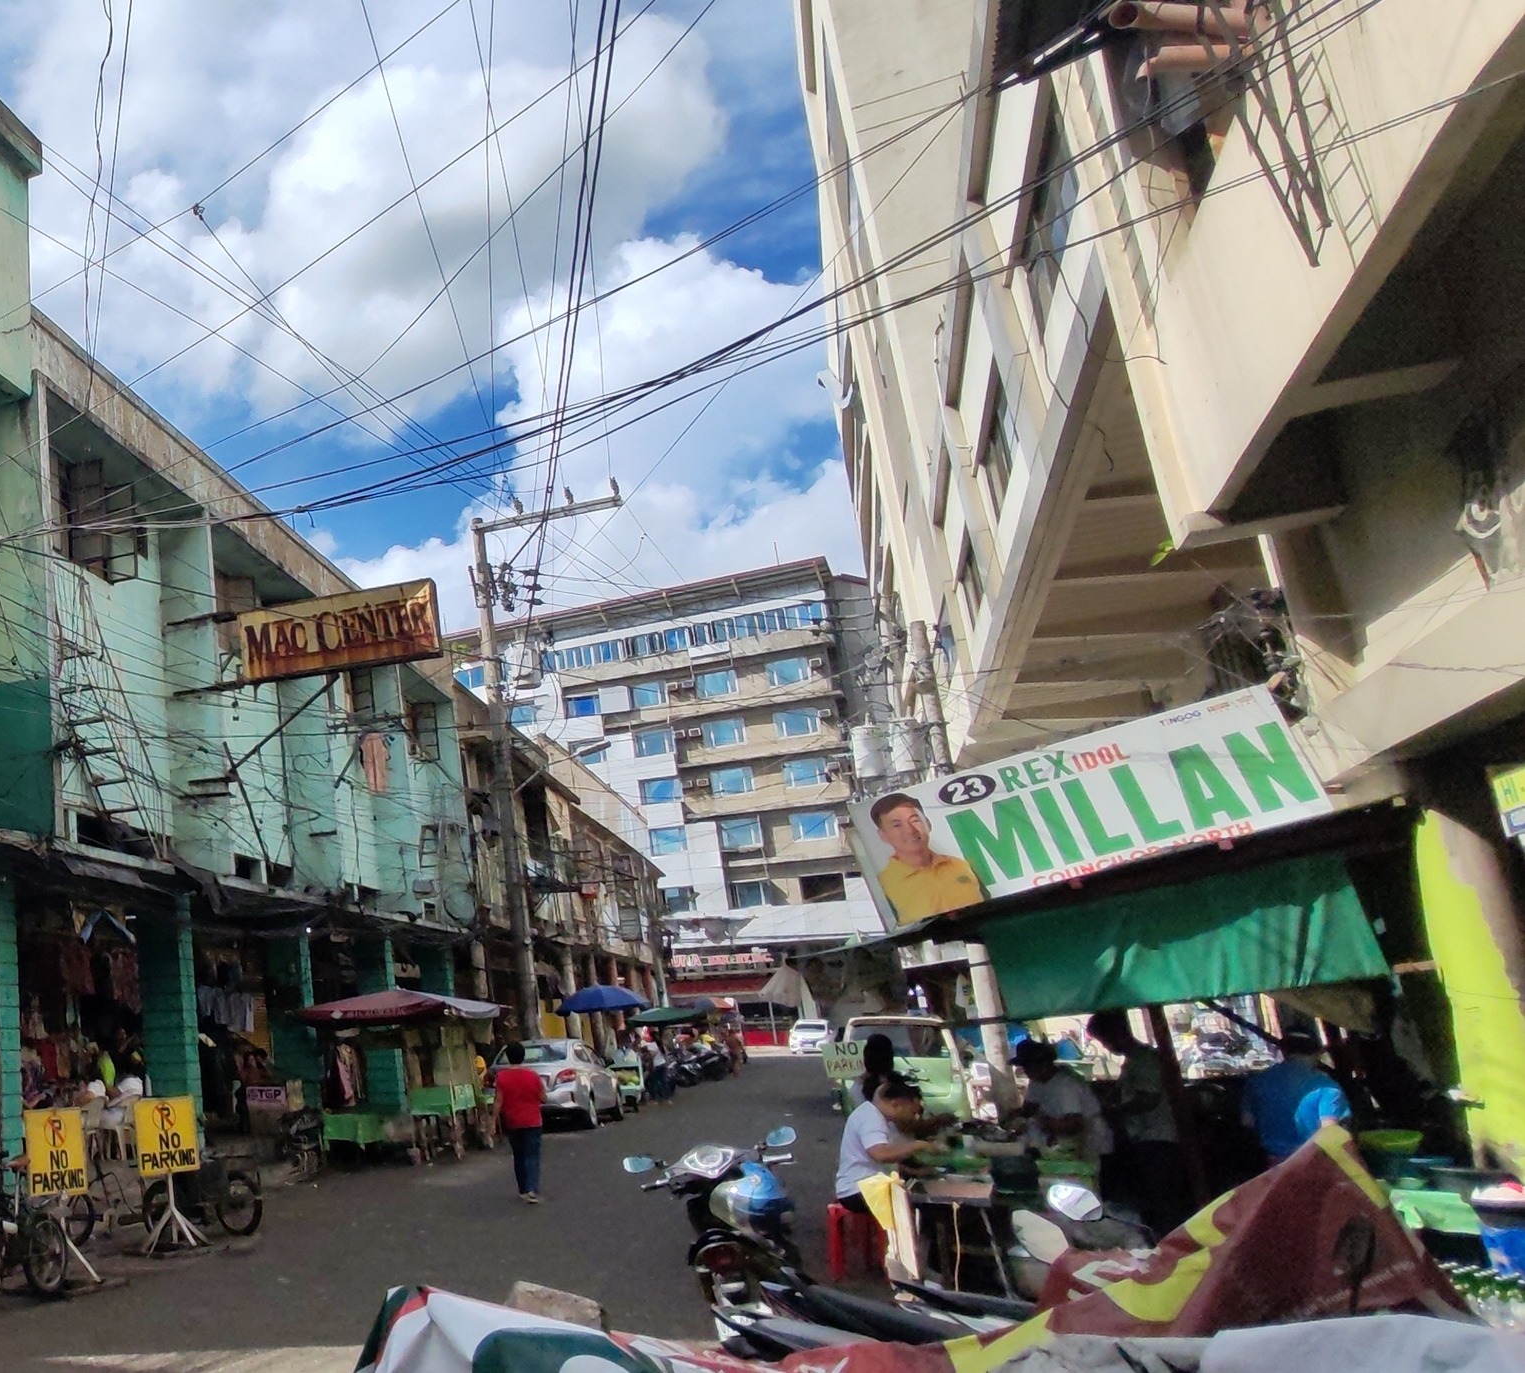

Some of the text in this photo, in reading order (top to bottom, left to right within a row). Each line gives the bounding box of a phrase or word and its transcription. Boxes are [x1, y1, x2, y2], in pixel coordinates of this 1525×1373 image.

[244, 598, 431, 663] MAC CENTER
[1159, 710, 1202, 727] TINGOG
[947, 743, 1131, 802] 23 REX IDOL
[945, 721, 1321, 886] MILLAN
[835, 1042, 858, 1056] NO
[257, 1089, 282, 1099] TGP
[159, 1132, 181, 1150] NO
[50, 1149, 68, 1170] NO
[141, 1148, 196, 1171] PARKING
[32, 1168, 84, 1194] PARKING
